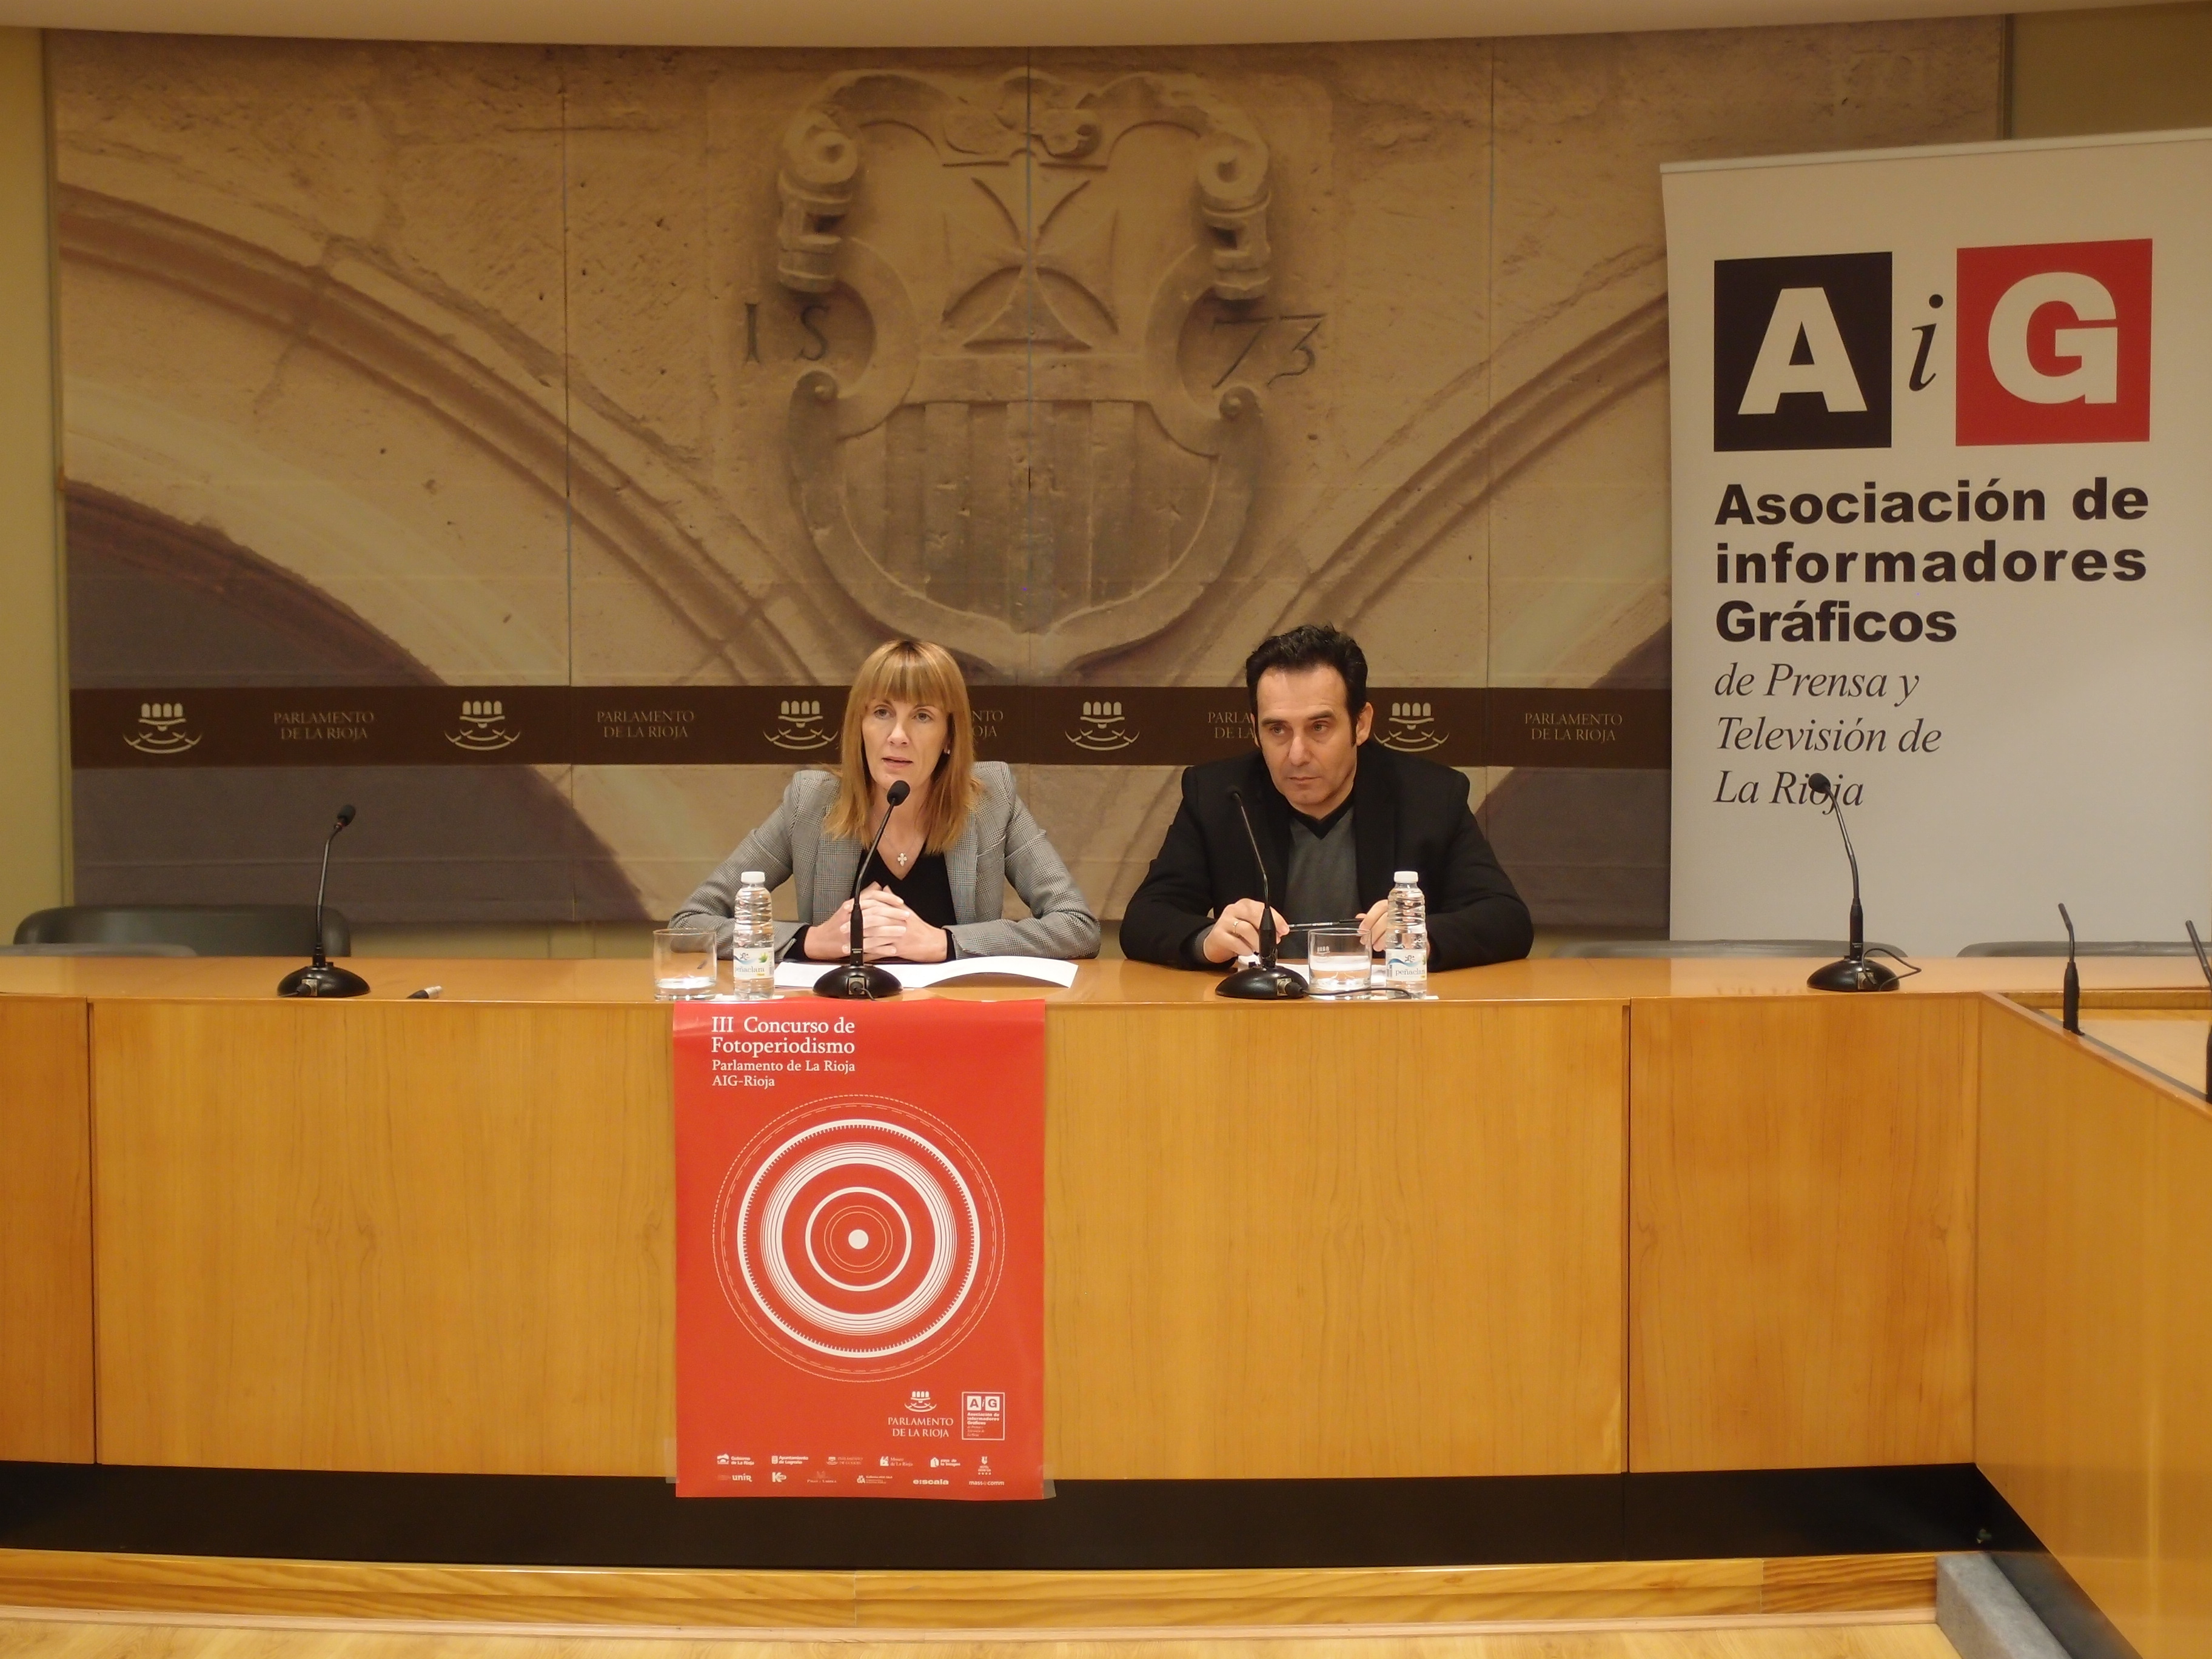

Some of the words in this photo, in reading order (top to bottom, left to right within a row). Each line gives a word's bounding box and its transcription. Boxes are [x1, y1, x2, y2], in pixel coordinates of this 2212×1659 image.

[1714, 478, 2046, 525] Asociación
[2072, 477, 2150, 522] de
[1715, 539, 2147, 584] informadores
[1715, 600, 1957, 643] Gráficos
[1714, 662, 1755, 697] de
[1763, 663, 1887, 699] Prensa
[1893, 672, 1920, 707] y
[273, 712, 374, 724] PARLAMENTO
[597, 711, 694, 723] PARLAMENTO
[1208, 711, 1252, 723] PARLA
[1525, 712, 1623, 726] PARLAMENTO
[281, 727, 301, 740] DE
[305, 728, 323, 740] LA
[327, 727, 368, 741] RIOJA
[603, 726, 623, 738] DE
[628, 726, 644, 738] LA
[648, 726, 688, 740] RIOJA
[1215, 727, 1235, 739] DE
[1238, 727, 1255, 739] LA
[1531, 728, 1550, 740] DE
[1555, 728, 1571, 740] LA
[1576, 729, 1615, 743] RIOJA
[1717, 716, 1886, 752] Televisión
[1898, 718, 1943, 754] de
[1713, 769, 1758, 805] La
[711, 1016, 733, 1033] III
[743, 1016, 829, 1034] Concurso
[833, 1016, 855, 1033] de
[711, 1036, 855, 1057] Fotoperiodismo
[712, 1060, 783, 1071] Parlamento
[786, 1060, 802, 1071] de
[805, 1060, 820, 1071] La
[823, 1060, 856, 1074] Rioja
[712, 1074, 775, 1090] AIG-Rioja
[888, 1416, 954, 1426] PARLAMENTO
[893, 1428, 906, 1436] DE
[908, 1429, 920, 1437] LA
[922, 1429, 950, 1438] RIOJA
